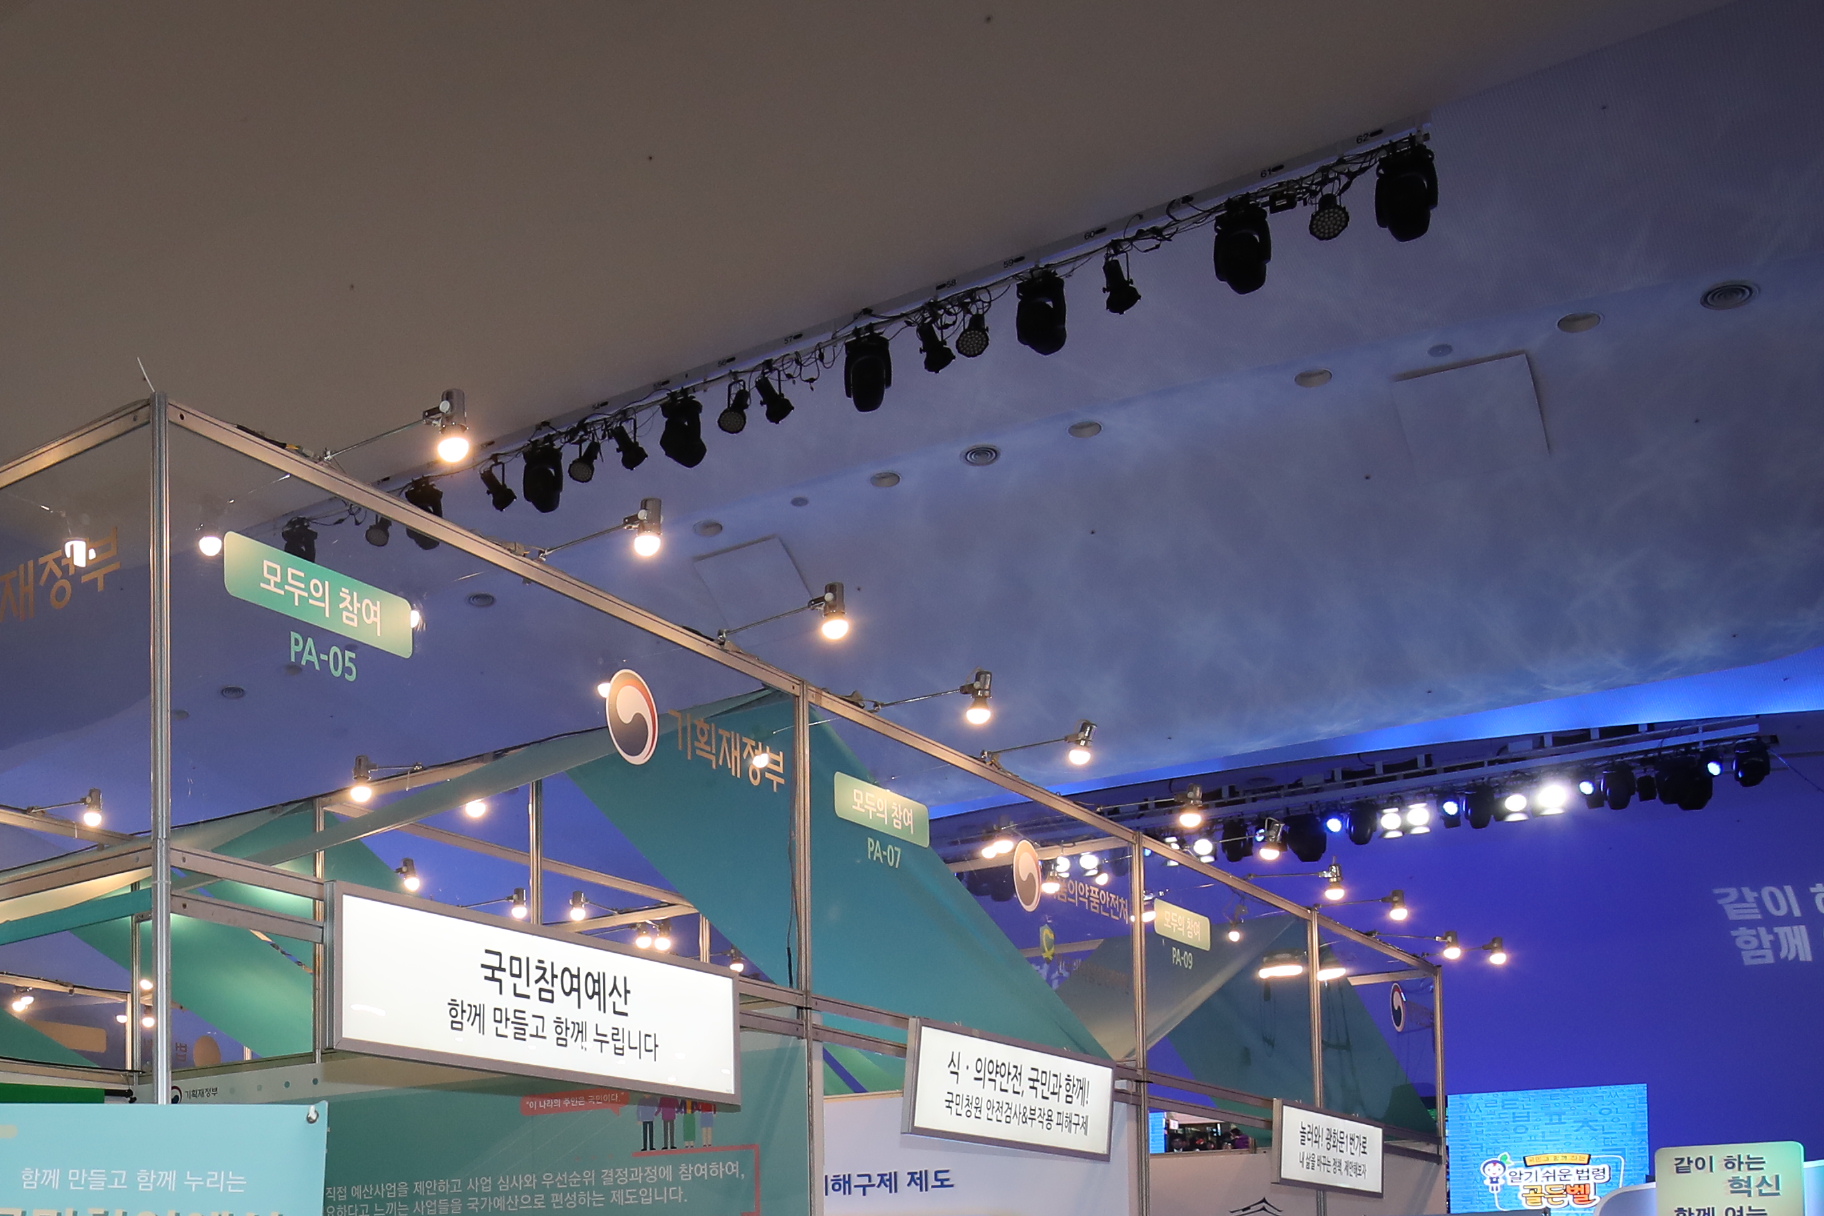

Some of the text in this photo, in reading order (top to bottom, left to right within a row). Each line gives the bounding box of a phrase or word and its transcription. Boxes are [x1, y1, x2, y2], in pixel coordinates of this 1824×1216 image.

[260, 558, 382, 637] 모두의 참여
[289, 630, 358, 683] PA-05
[668, 709, 785, 793] 기획재정부
[852, 787, 914, 835] 모두의 참여
[867, 837, 902, 869] PA-07
[1055, 877, 1128, 924] 품의약품안전처
[1712, 885, 1802, 920] 같이
[1164, 911, 1201, 941] 모두의 참여
[1172, 947, 1192, 969] PA-09
[1731, 925, 1812, 966] 함께
[481, 948, 631, 1017] 국민참여예산
[448, 998, 659, 1062] 함께 만들고 함께 누립니다
[185, 1088, 218, 1100] 기획재정부
[947, 1051, 1090, 1106] 식 의약안전, 국민과 함께!
[944, 1095, 1089, 1136] 국민청원 안전검사&부작용 피해구제
[21, 1168, 246, 1193] 함께 만들고 함께 누리는
[326, 1161, 744, 1201] 직접 예산사업을 제안하고 사업 심사와 우선순위 결정과정에 참여하여,
[907, 1169, 954, 1193] 제도
[1509, 1167, 1605, 1182] 알기 쉬운 법령
[1674, 1154, 1765, 1174] 같이 하는
[1523, 1183, 1597, 1205] 골든벨
[1728, 1175, 1781, 1197] 혁신
